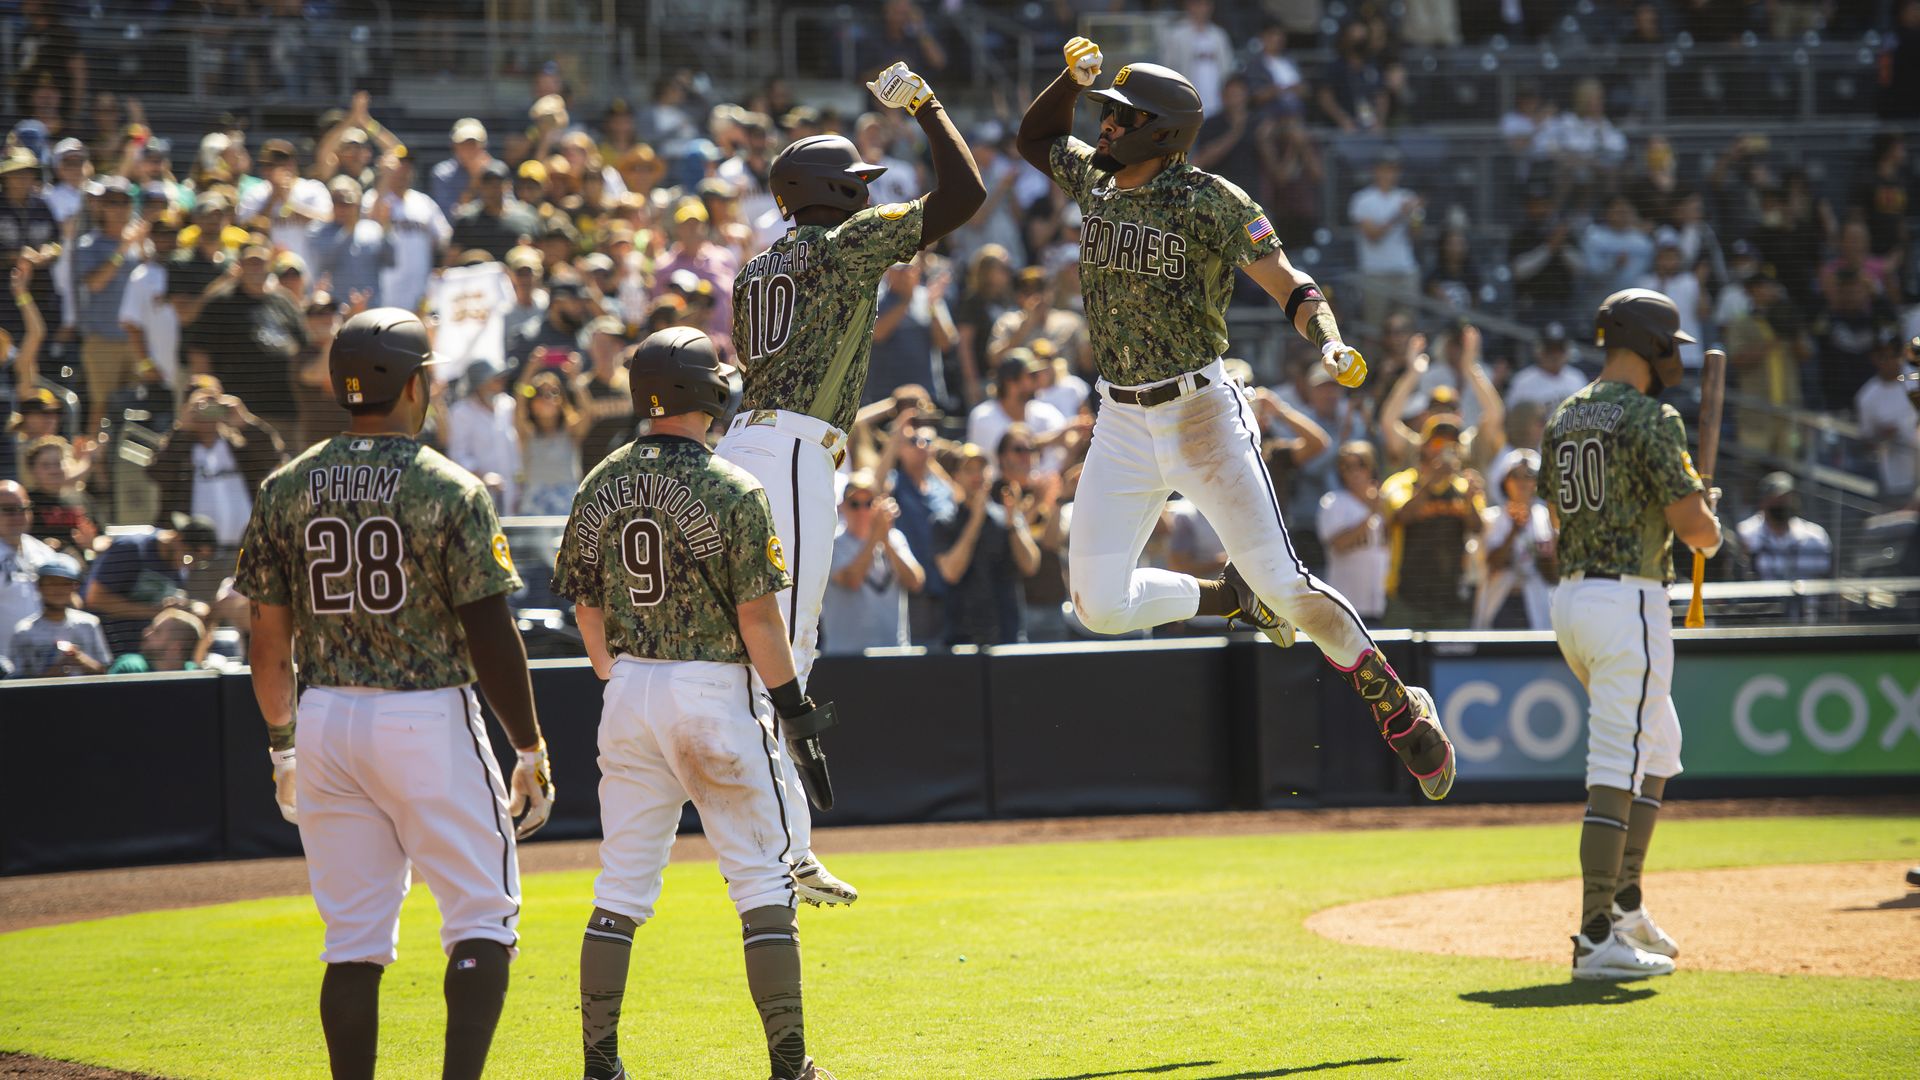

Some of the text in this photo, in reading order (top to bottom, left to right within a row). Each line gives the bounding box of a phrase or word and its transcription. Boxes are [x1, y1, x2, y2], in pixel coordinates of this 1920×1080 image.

[748, 273, 796, 360] 10
[345, 377, 361, 392] 28
[650, 394, 659, 407] 9
[310, 465, 401, 505] PHAM
[1556, 438, 1605, 513] 30
[576, 473, 724, 565] CRONENWORTH
[304, 516, 408, 614] 28
[621, 518, 666, 607] 9
[1443, 679, 1582, 763] CO
[1732, 672, 1920, 756] COX
